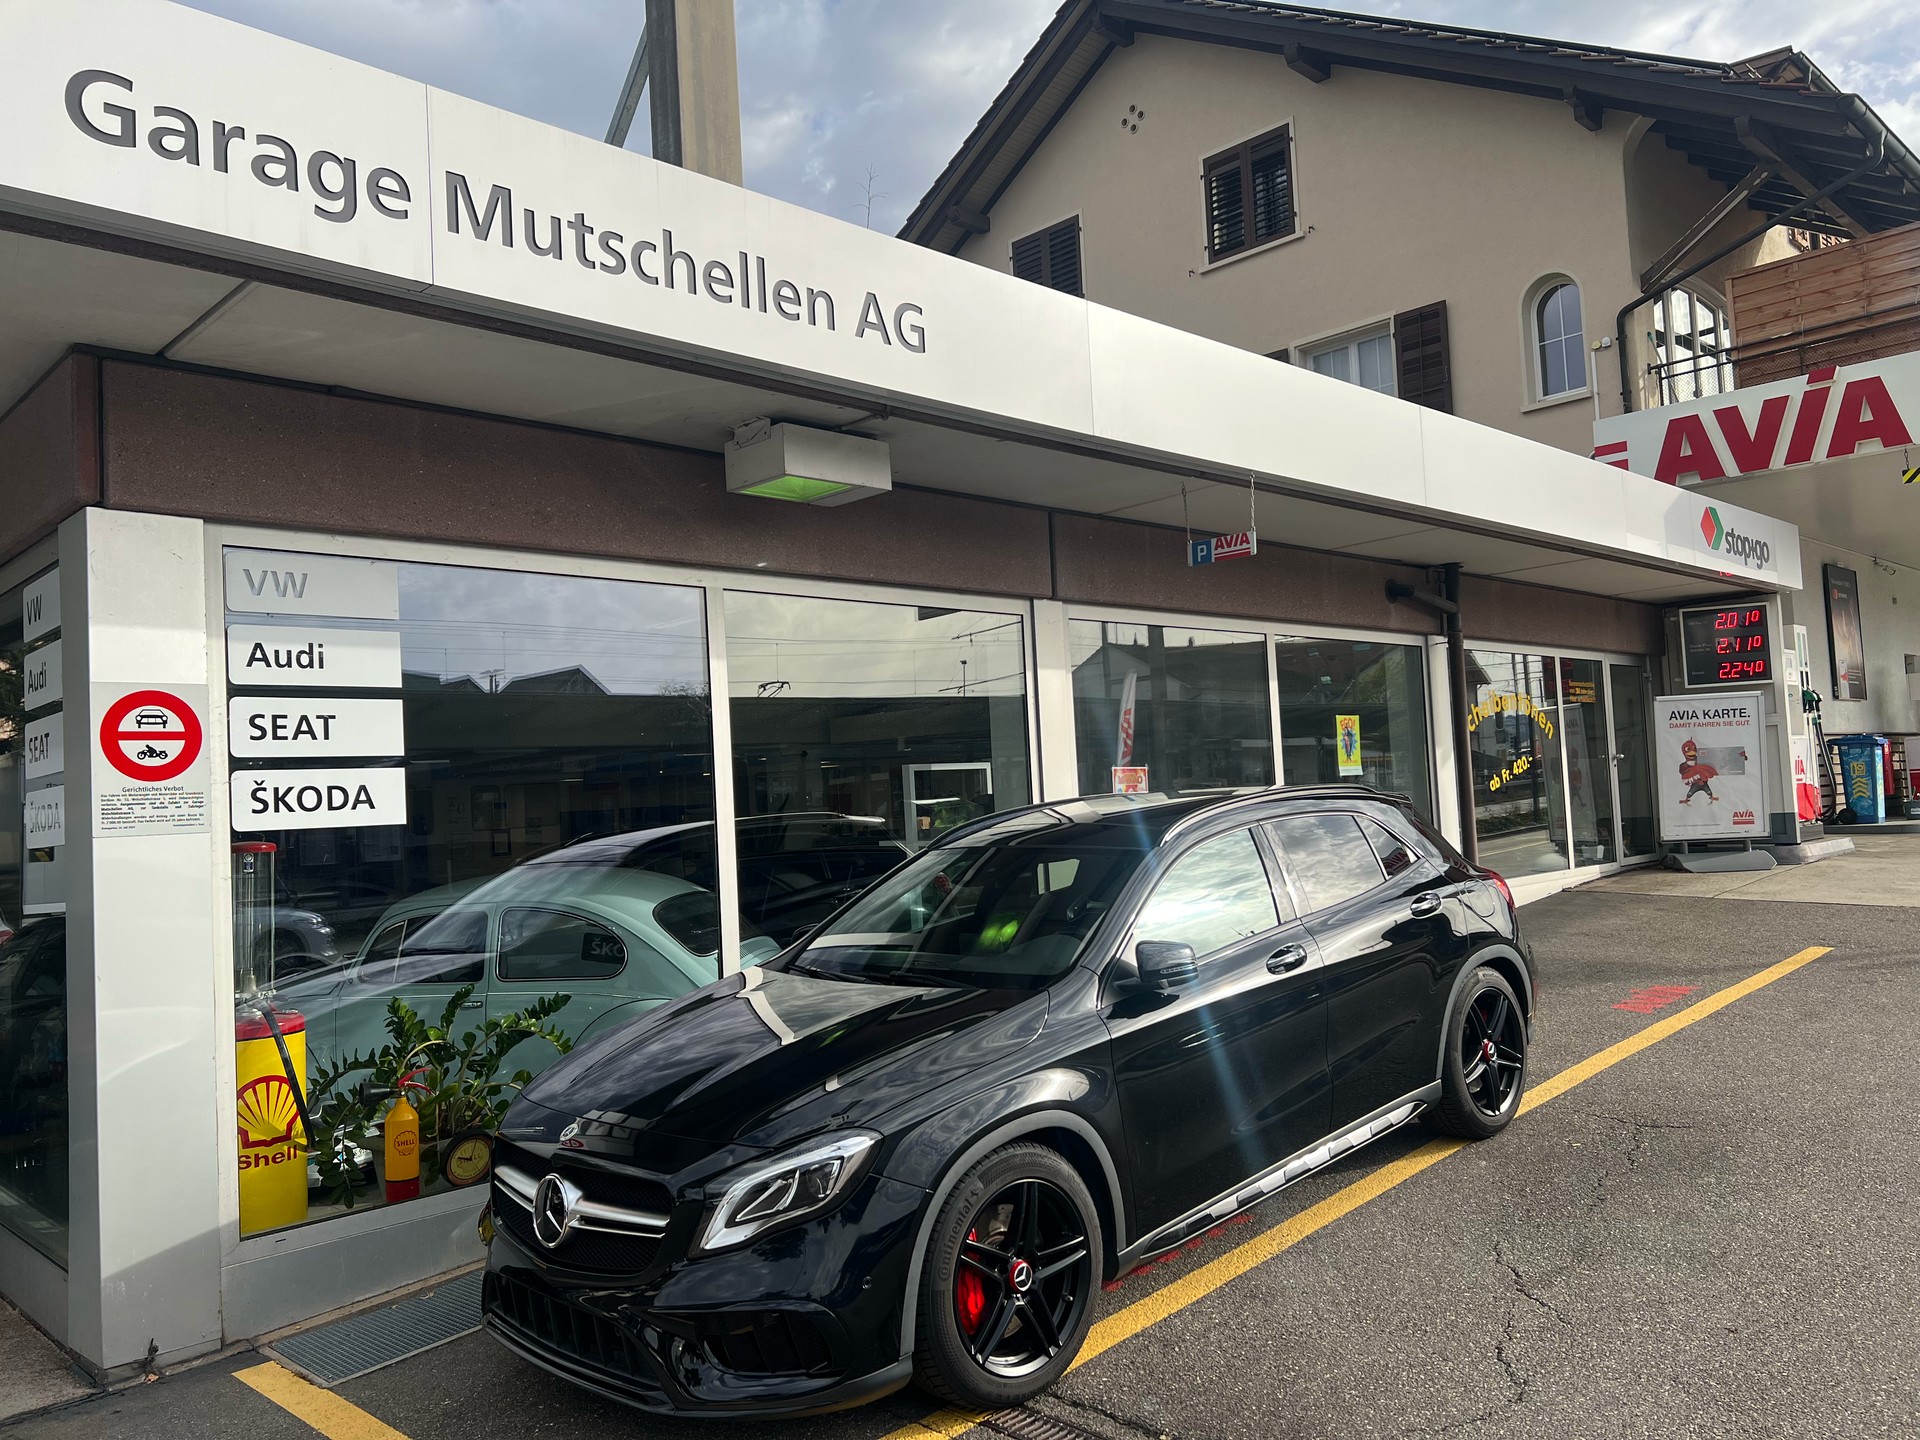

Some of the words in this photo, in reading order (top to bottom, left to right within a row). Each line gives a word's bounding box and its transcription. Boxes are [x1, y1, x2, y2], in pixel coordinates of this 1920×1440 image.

[64, 69, 411, 223] Garage
[445, 169, 836, 330] Mutschellen
[855, 291, 927, 354] AG
[1654, 366, 1914, 486] AVIA
[1214, 532, 1251, 551] AVIA
[243, 568, 309, 599] VW
[26, 594, 42, 625] VW
[246, 642, 325, 670] Audi
[28, 661, 47, 694] Audi
[249, 714, 337, 740] SEAT
[1467, 689, 1555, 740] cheibentönen
[1669, 710, 1699, 721] AVIA
[1703, 708, 1751, 720] KARTE.
[28, 732, 50, 763] SEAT
[1489, 773, 1500, 792] ab
[1501, 767, 1513, 783] Fr.
[250, 780, 376, 814] ŠKODA
[29, 801, 61, 834] ŠKODA
[1733, 809, 1754, 818] AVIA
[397, 1138, 415, 1147] SHELL
[937, 1197, 973, 1282] Continental
